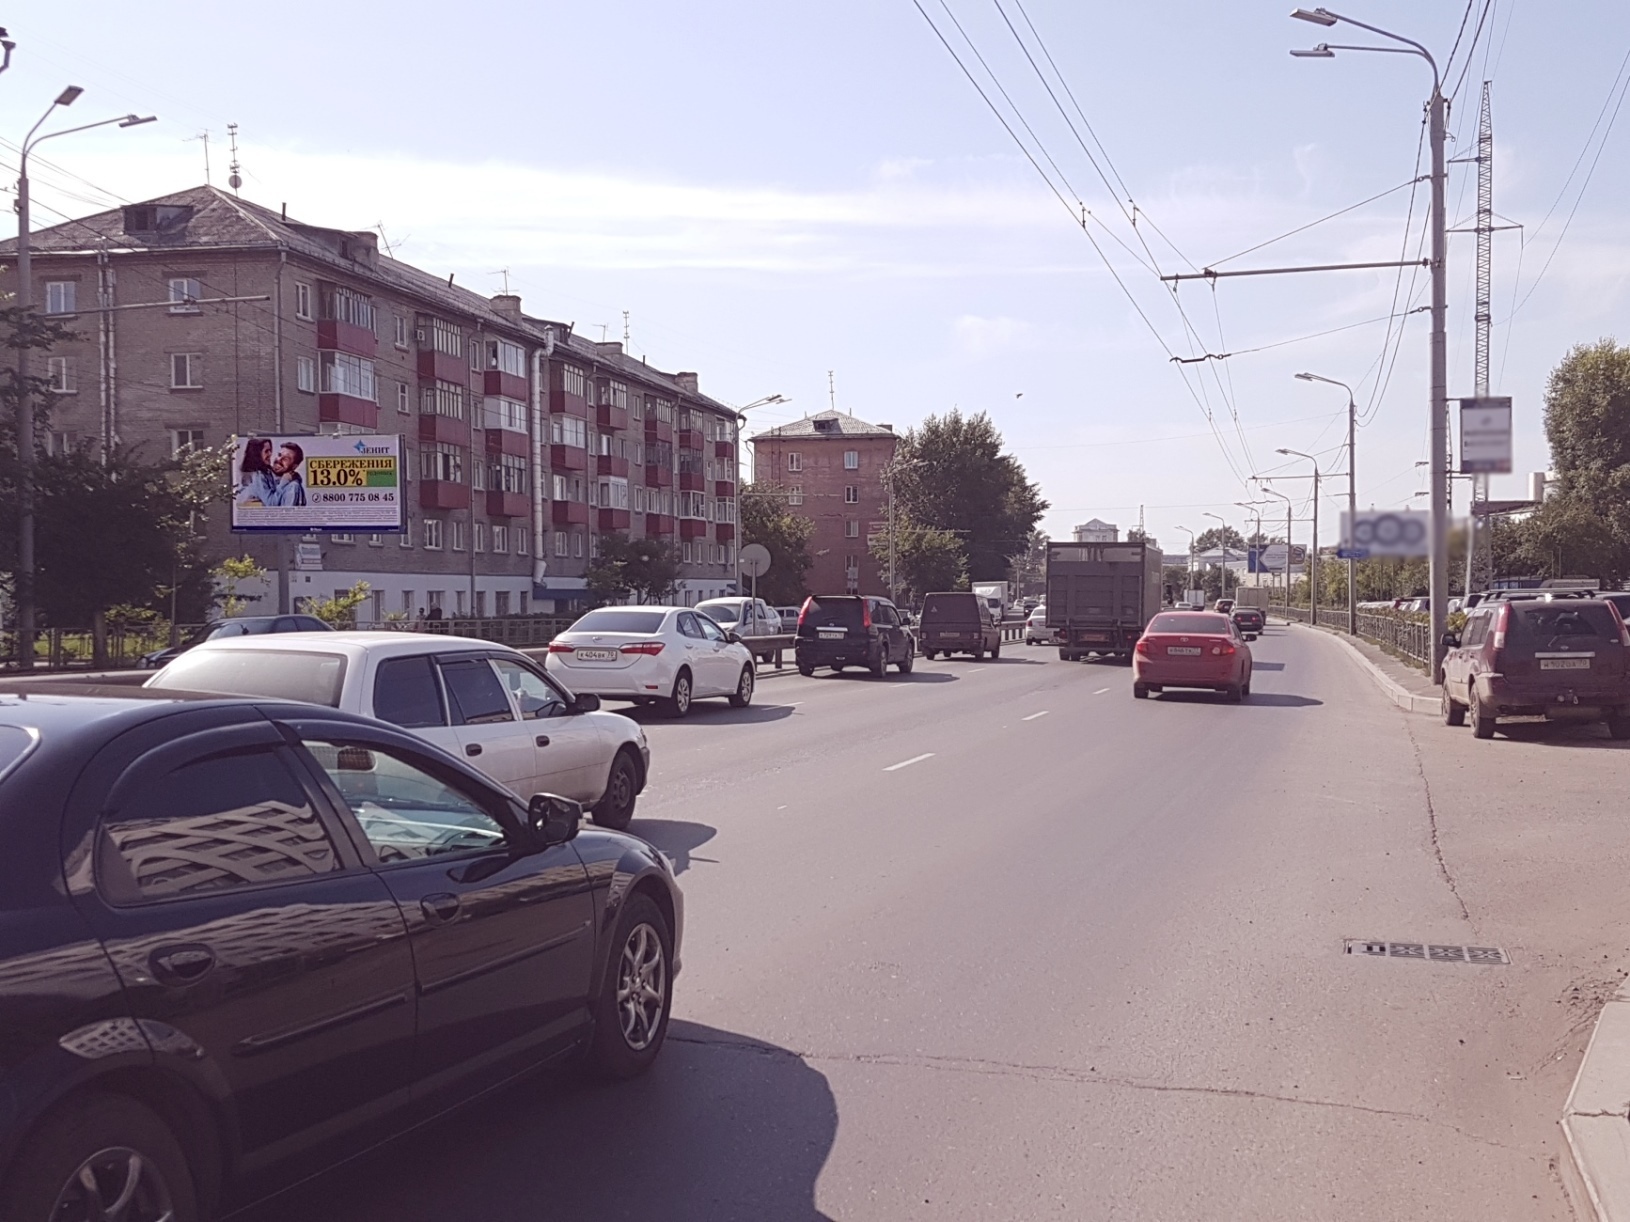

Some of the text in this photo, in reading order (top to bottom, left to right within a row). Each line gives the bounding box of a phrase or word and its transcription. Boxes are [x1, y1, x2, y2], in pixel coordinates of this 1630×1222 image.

[309, 459, 392, 469] СБЕРЕЖЕНИЯ
[322, 493, 394, 502] 8800 775 08 45
